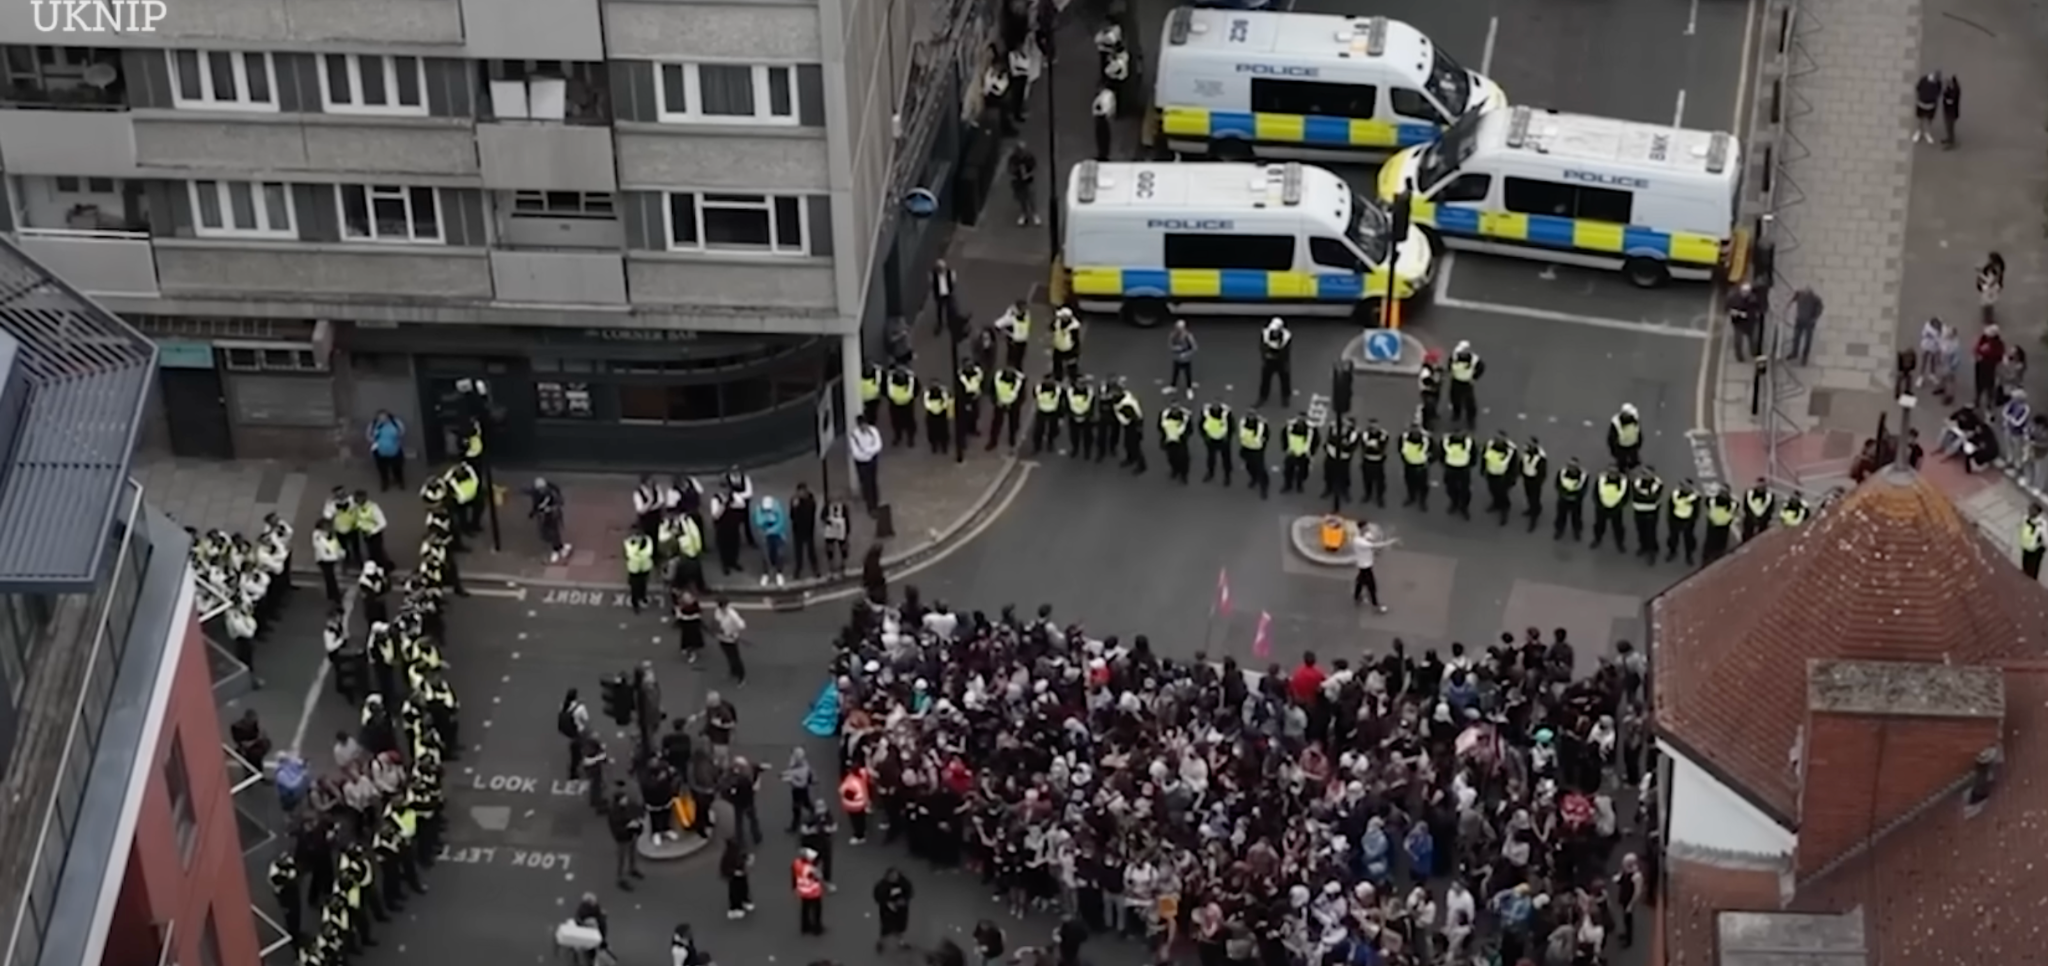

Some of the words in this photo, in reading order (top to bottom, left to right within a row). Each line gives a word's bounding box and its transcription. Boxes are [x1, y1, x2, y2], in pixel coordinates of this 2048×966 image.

[1235, 63, 1320, 78] POLICE
[1562, 168, 1650, 189] POLICE
[1147, 219, 1235, 231] POLICE
[1307, 394, 1330, 427] LEFT
[542, 589, 603, 606] RIGHT
[472, 774, 538, 793] LOOK
[550, 779, 591, 796] LEF
[436, 844, 497, 863] LEFT
[511, 851, 571, 871] LOOK
